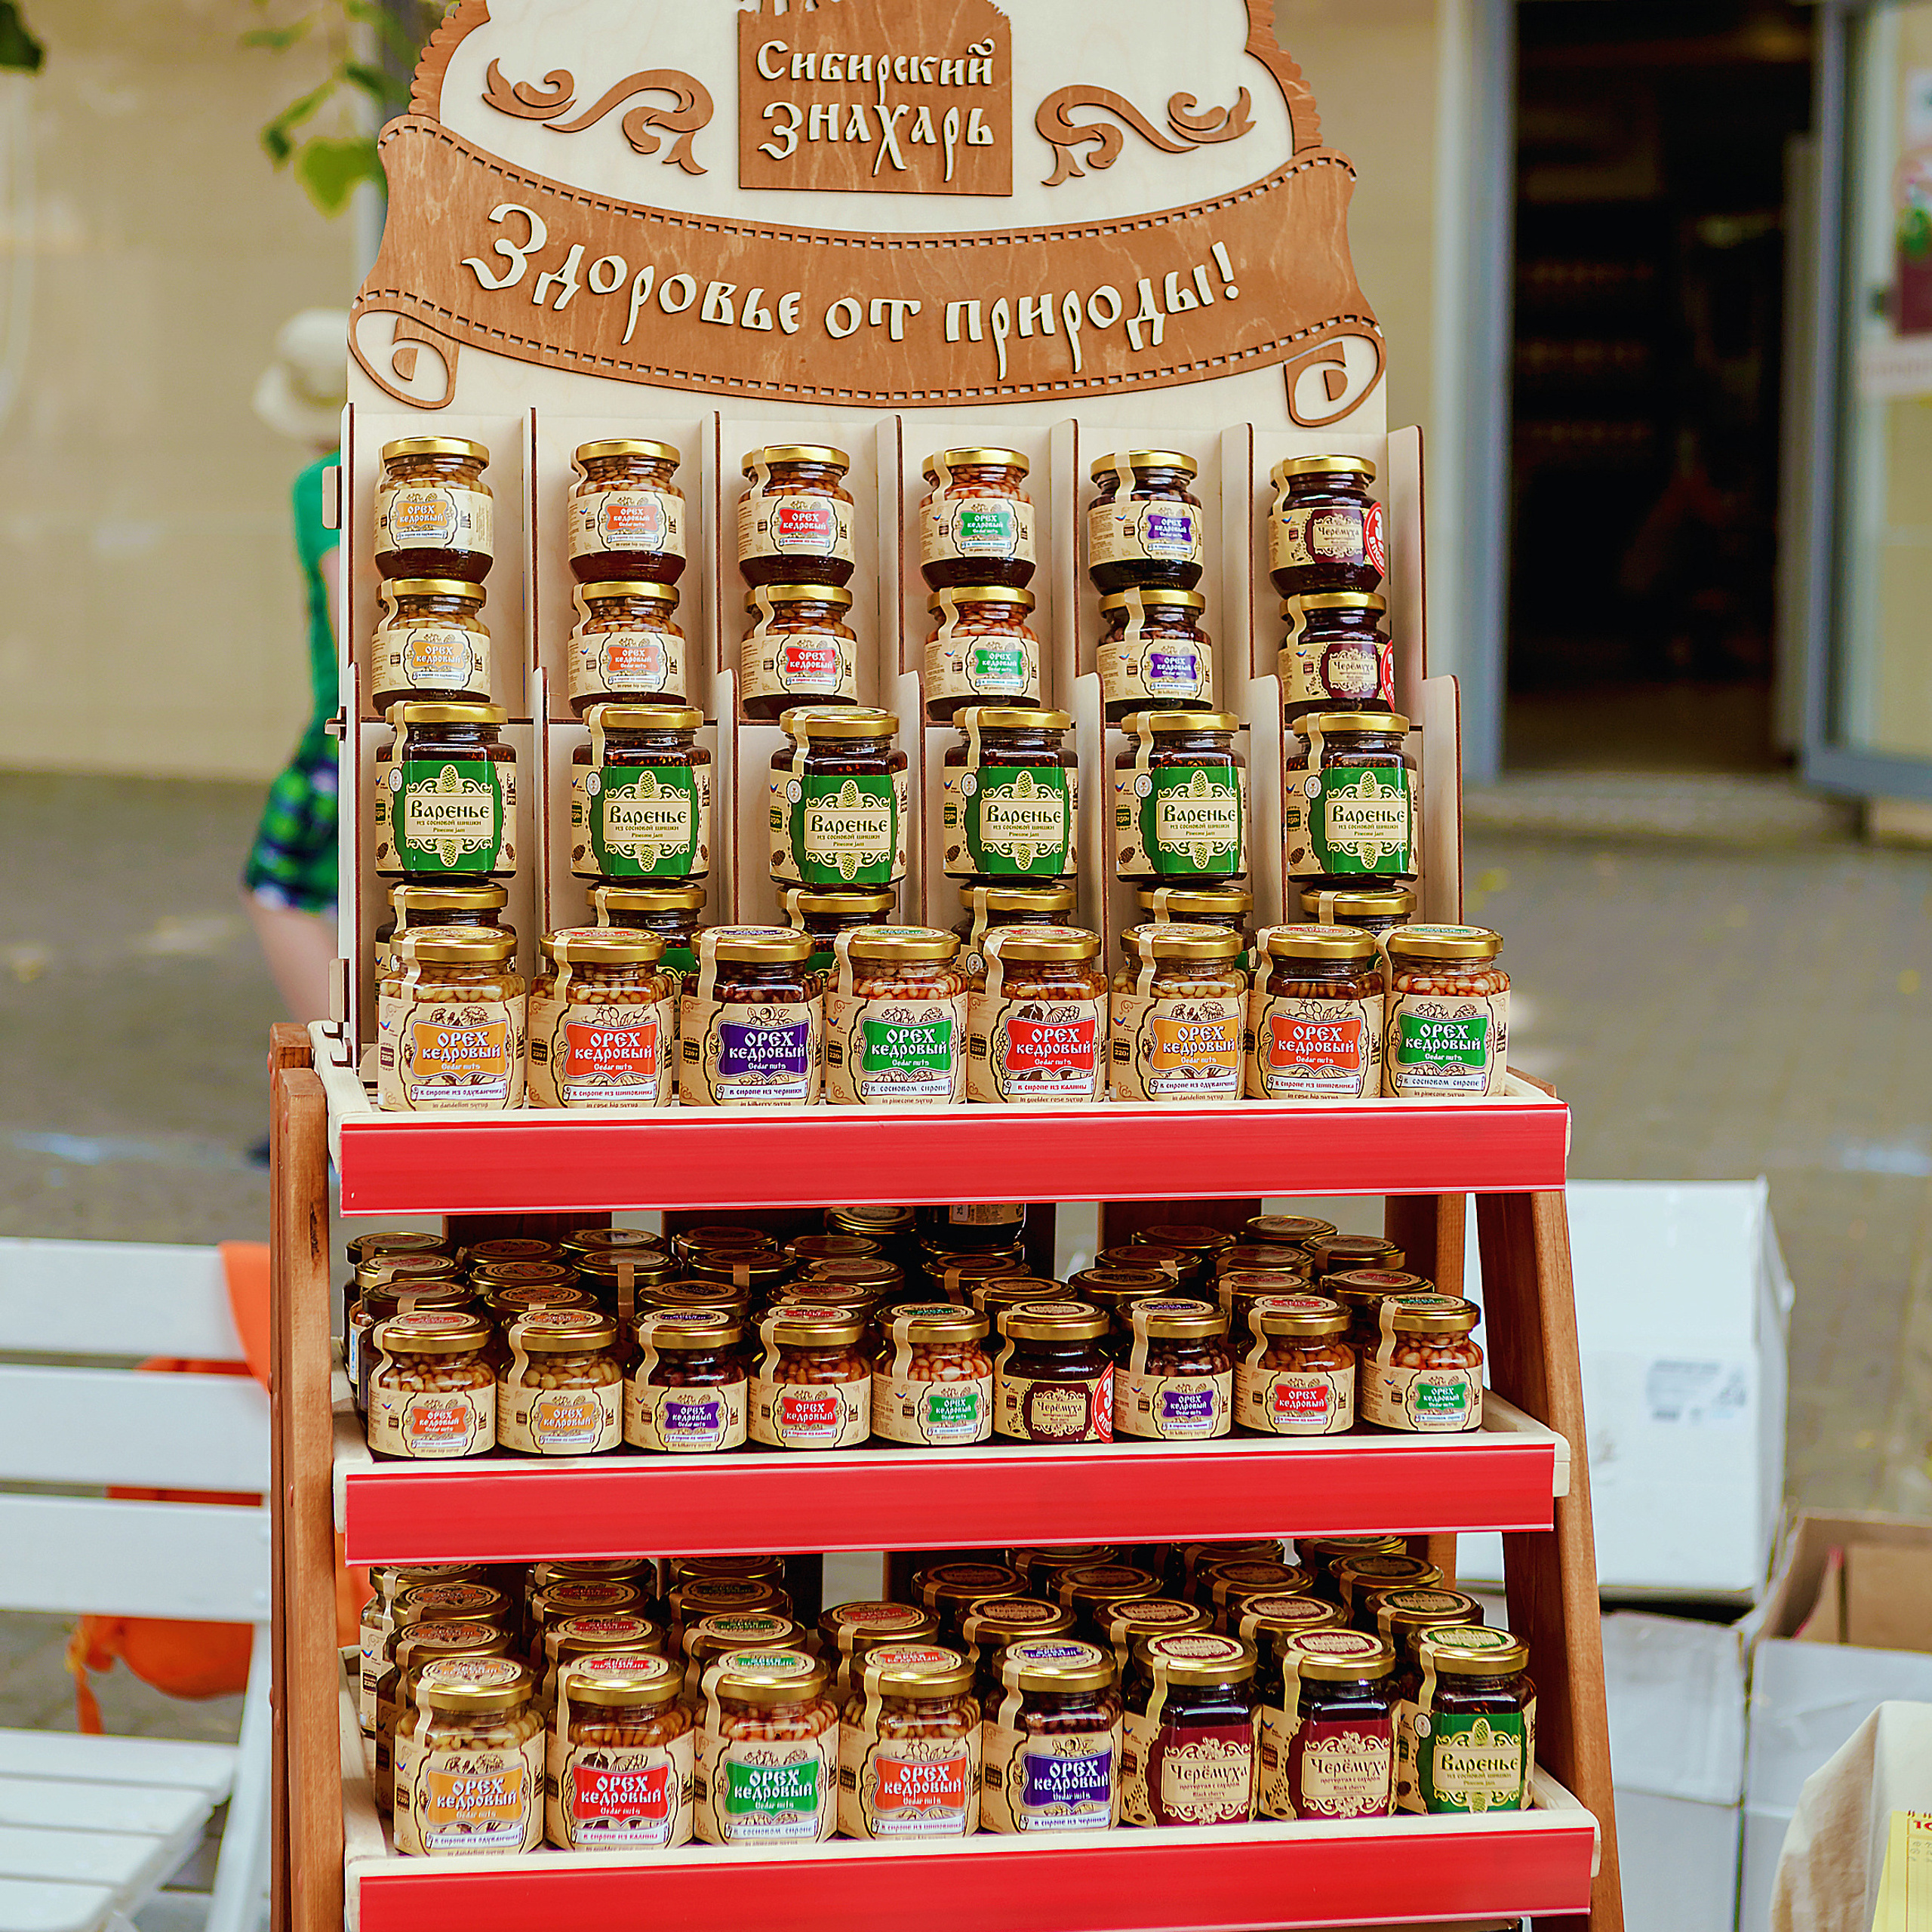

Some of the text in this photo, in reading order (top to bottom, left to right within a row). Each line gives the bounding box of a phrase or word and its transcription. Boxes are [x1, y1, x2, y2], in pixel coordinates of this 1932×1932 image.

[755, 38, 997, 97] Сибирский
[755, 100, 995, 183] Знахарь
[461, 202, 1239, 380] Здоровье от природы!
[410, 800, 489, 820] Варенье
[609, 805, 687, 825] Варенье
[986, 805, 1061, 825] Варенье
[1163, 804, 1235, 823] Варенье
[1331, 805, 1404, 824] Варенье
[811, 815, 888, 834] Варенье
[437, 1032, 489, 1048] ОРЕХ
[590, 1032, 641, 1048] ОРЕХ
[745, 1032, 794, 1047] ОРЕХ
[887, 1029, 936, 1044] ОРЕХ
[1032, 1029, 1079, 1043] ОРЕХ
[1177, 1026, 1225, 1041] ОРЕХ
[1293, 1026, 1342, 1041] ОРЕХ
[1420, 1023, 1469, 1039] ОРЕХ
[423, 1044, 501, 1063] кедровый
[575, 1045, 652, 1063] кедровый
[730, 1044, 804, 1062] кедровый
[872, 1041, 947, 1059] кедровый
[1017, 1040, 1091, 1058] кедровый
[1163, 1038, 1235, 1057] кедровый
[1278, 1040, 1354, 1056] кедровый
[1405, 1037, 1481, 1053] кедровый
[553, 1408, 583, 1419] ОРЕХ
[1050, 1761, 1100, 1779] ОРЕХ
[1441, 1754, 1518, 1773] Варенье
[749, 1769, 801, 1786] ОРЕХ
[899, 1765, 950, 1783] ОРЕХ
[452, 1778, 506, 1796] ОРЕХ
[596, 1775, 649, 1792] ОРЕХ
